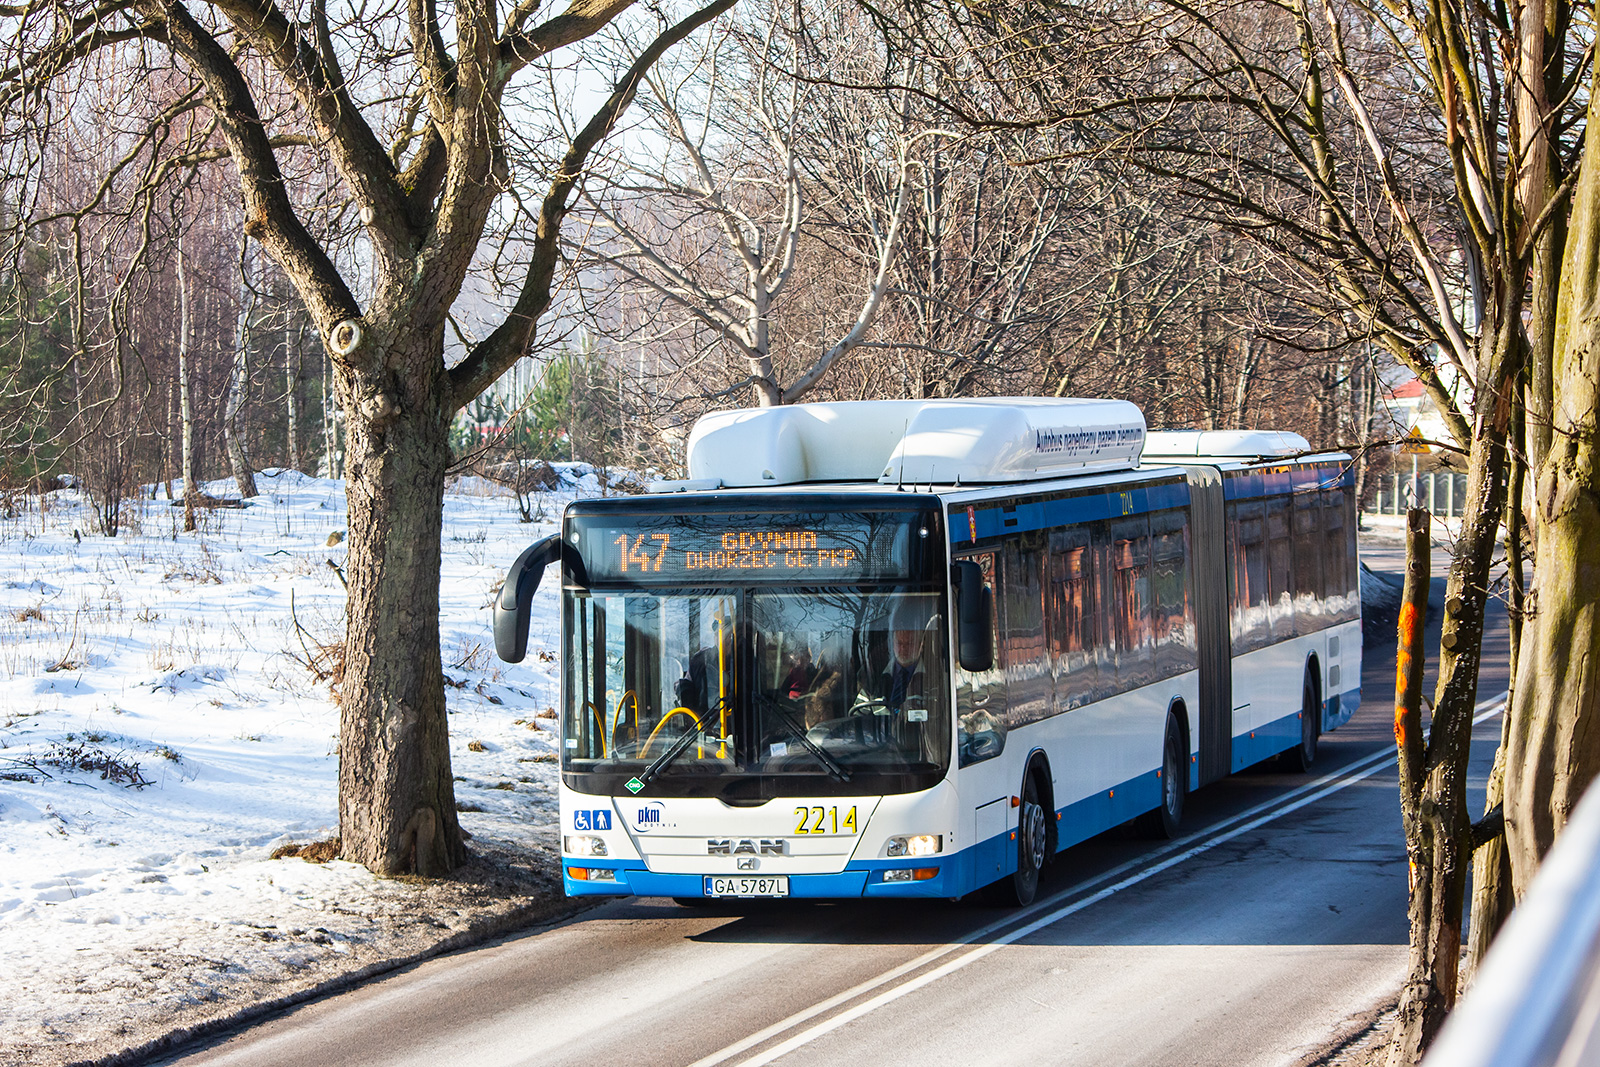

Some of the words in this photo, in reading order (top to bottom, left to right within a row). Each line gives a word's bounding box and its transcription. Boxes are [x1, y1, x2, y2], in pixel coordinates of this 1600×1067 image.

[1035, 429, 1063, 453] Autobus
[1096, 430, 1117, 455] gazem
[1116, 424, 1142, 451] ziemnym
[1120, 492, 1134, 515] 2214
[721, 531, 817, 550] GDYNIA
[613, 532, 671, 572] 147
[686, 551, 776, 569] DWORZEC
[818, 549, 855, 567] PKP
[638, 806, 660, 824] pkm
[793, 805, 858, 835] 2214
[707, 839, 787, 856] MAN
[714, 879, 736, 894] GA
[740, 879, 786, 894] 5787L
